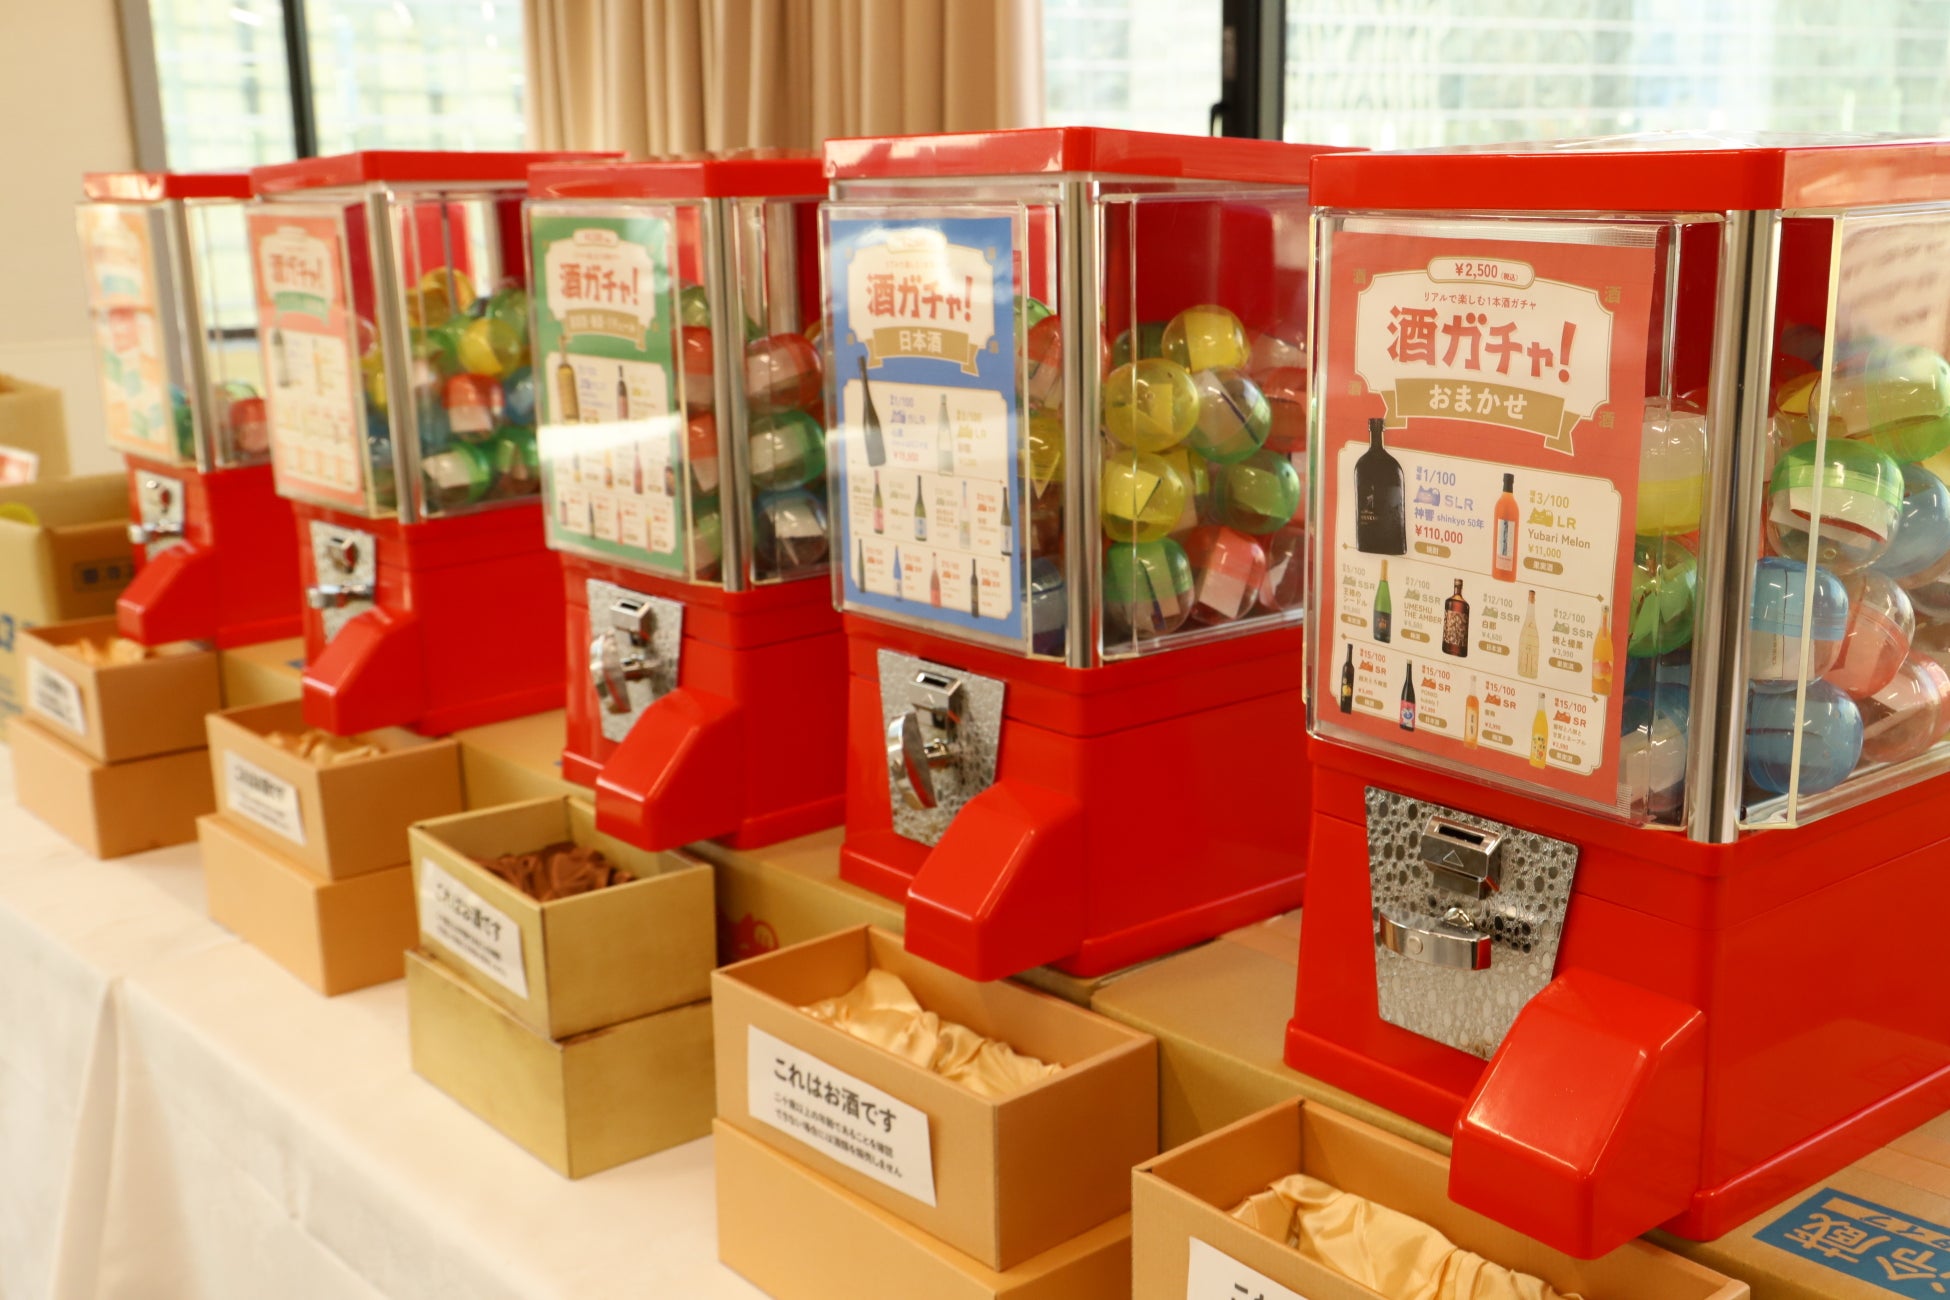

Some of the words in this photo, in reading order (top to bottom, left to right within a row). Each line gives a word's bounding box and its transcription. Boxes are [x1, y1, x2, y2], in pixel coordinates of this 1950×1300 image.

[1455, 262, 1498, 279] ¥2,500
[560, 262, 639, 305] 酒ガチャ!
[866, 274, 973, 322] 酒ガチャ!
[1423, 291, 1537, 310] リアルで楽しむ1本酒ガチャ
[1605, 286, 1621, 305] 酒
[899, 330, 943, 354] 日本酒
[1386, 304, 1577, 384] 酒ガチャ!
[1429, 384, 1528, 420] おまかせ
[1423, 470, 1456, 486] 1/100
[1445, 495, 1474, 511] SLR
[1537, 493, 1570, 509] 3/100
[1437, 512, 1466, 527] shinkyo
[1467, 518, 1485, 530] 50年
[1557, 515, 1577, 530] LR
[1415, 524, 1463, 544] ¥110,000
[1528, 528, 1559, 544] Yubari
[1561, 536, 1591, 550] Melon
[1528, 544, 1562, 559] ¥11,000
[1422, 594, 1441, 605] SSR
[1404, 602, 1433, 614] UMESHU
[1404, 610, 1419, 620] THE
[1419, 613, 1442, 625] AMBER
[1500, 612, 1521, 623] SSR
[1572, 628, 1594, 640] SSR
[1364, 650, 1386, 663] 15/100
[1375, 665, 1387, 676] SR
[1426, 667, 1451, 681] 15/100
[1438, 682, 1451, 693] SR
[1490, 682, 1516, 697] 15/100
[1503, 698, 1516, 710] SR
[1559, 699, 1587, 714] 15/100
[1573, 716, 1587, 728] SR
[774, 1058, 897, 1133] これはお酒です
